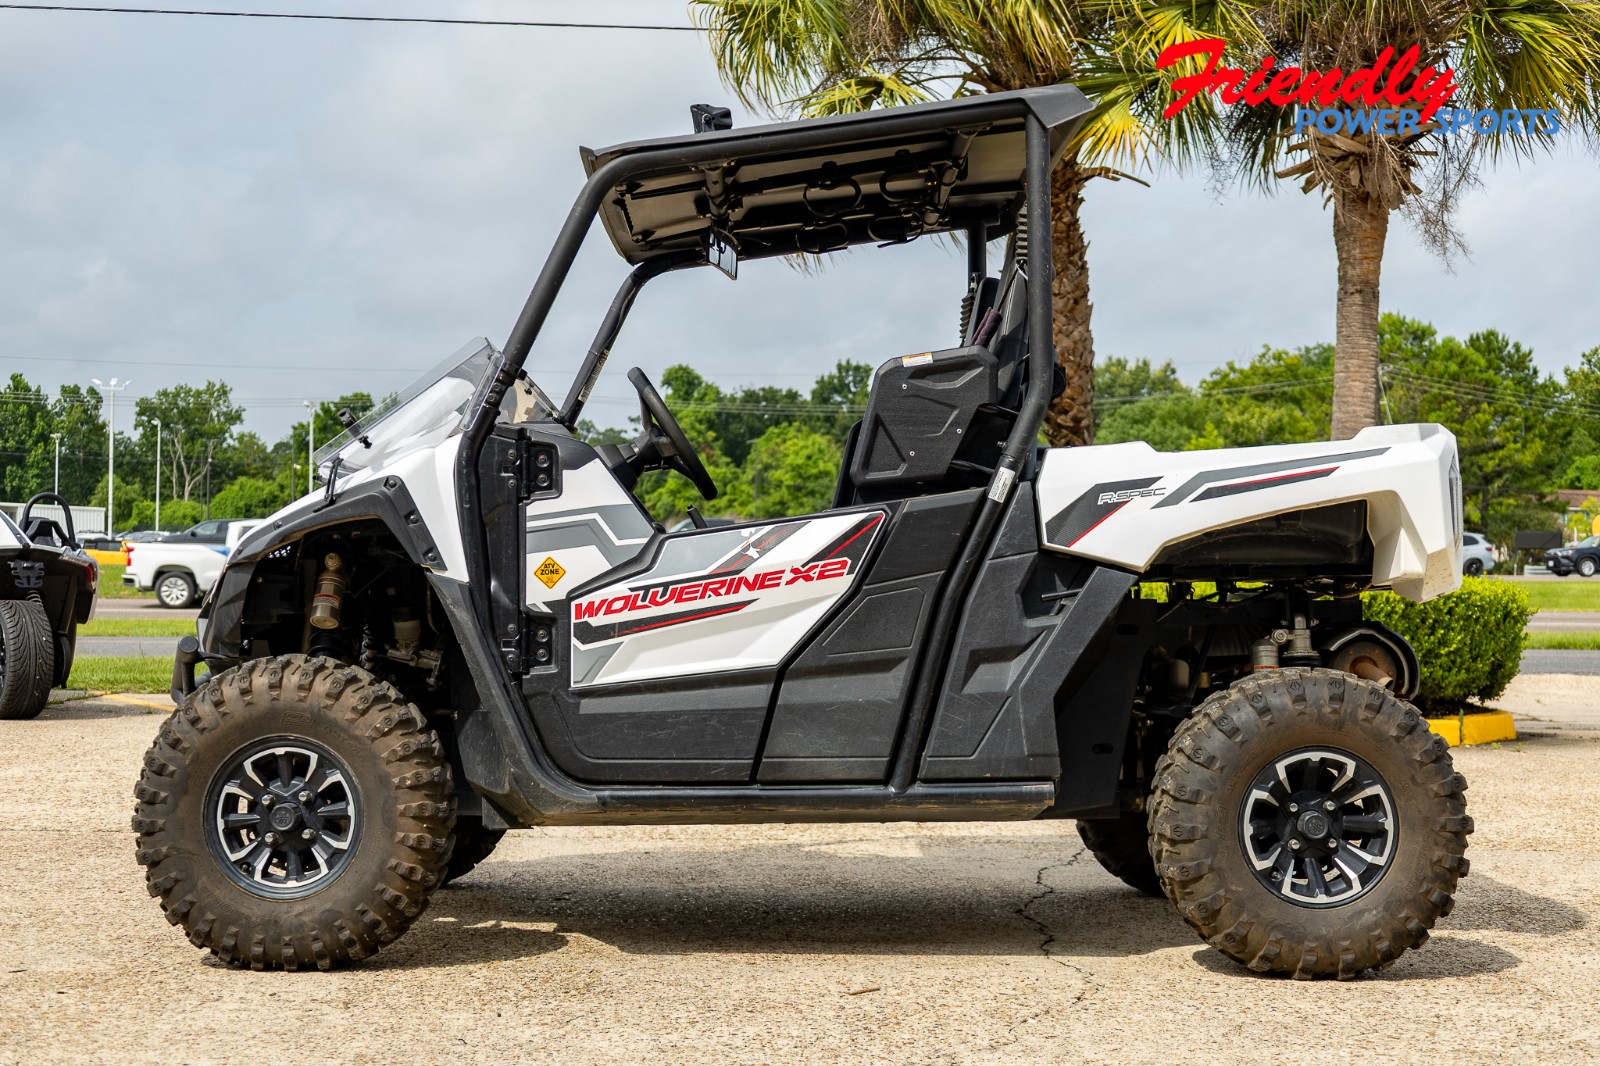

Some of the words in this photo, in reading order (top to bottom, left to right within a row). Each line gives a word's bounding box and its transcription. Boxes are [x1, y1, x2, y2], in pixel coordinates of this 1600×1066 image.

[540, 568, 560, 576] ZONE
[574, 569, 783, 620] WOLVERINE
[784, 559, 849, 587] X2
